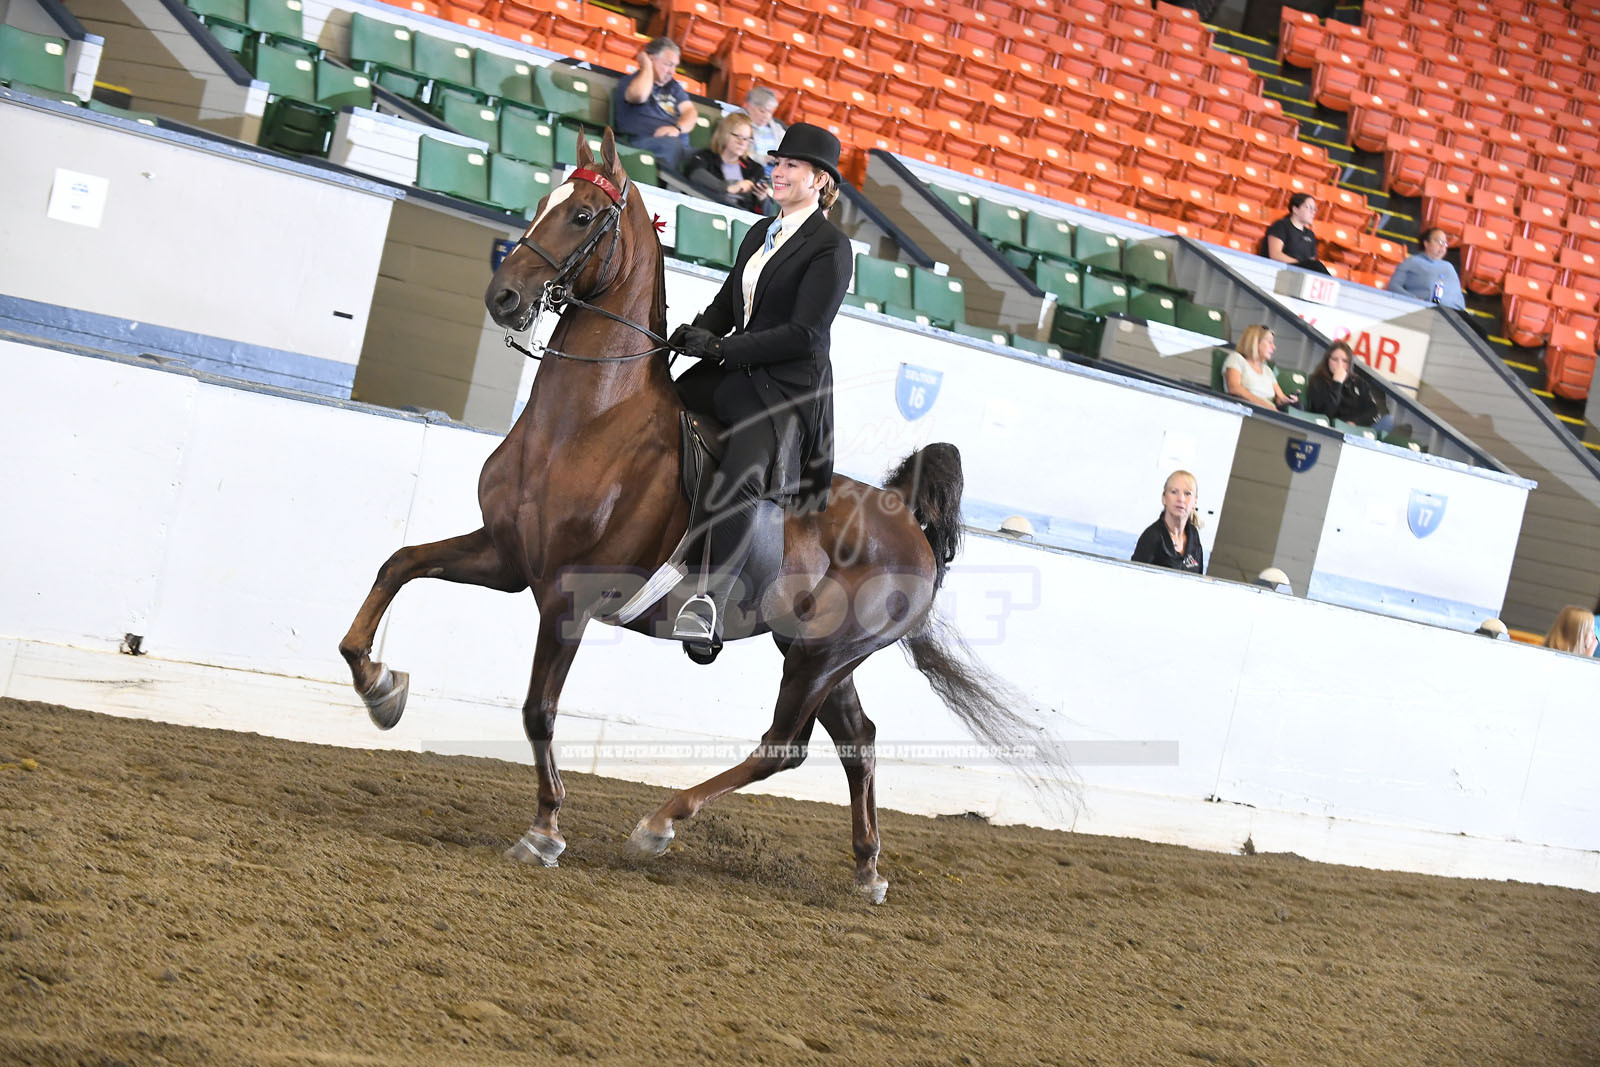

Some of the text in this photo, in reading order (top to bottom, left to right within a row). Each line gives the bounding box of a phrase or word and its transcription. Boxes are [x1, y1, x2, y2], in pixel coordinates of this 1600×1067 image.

[1309, 277, 1335, 303] EXIT
[908, 385, 927, 409] 16
[1417, 508, 1433, 528] 17
